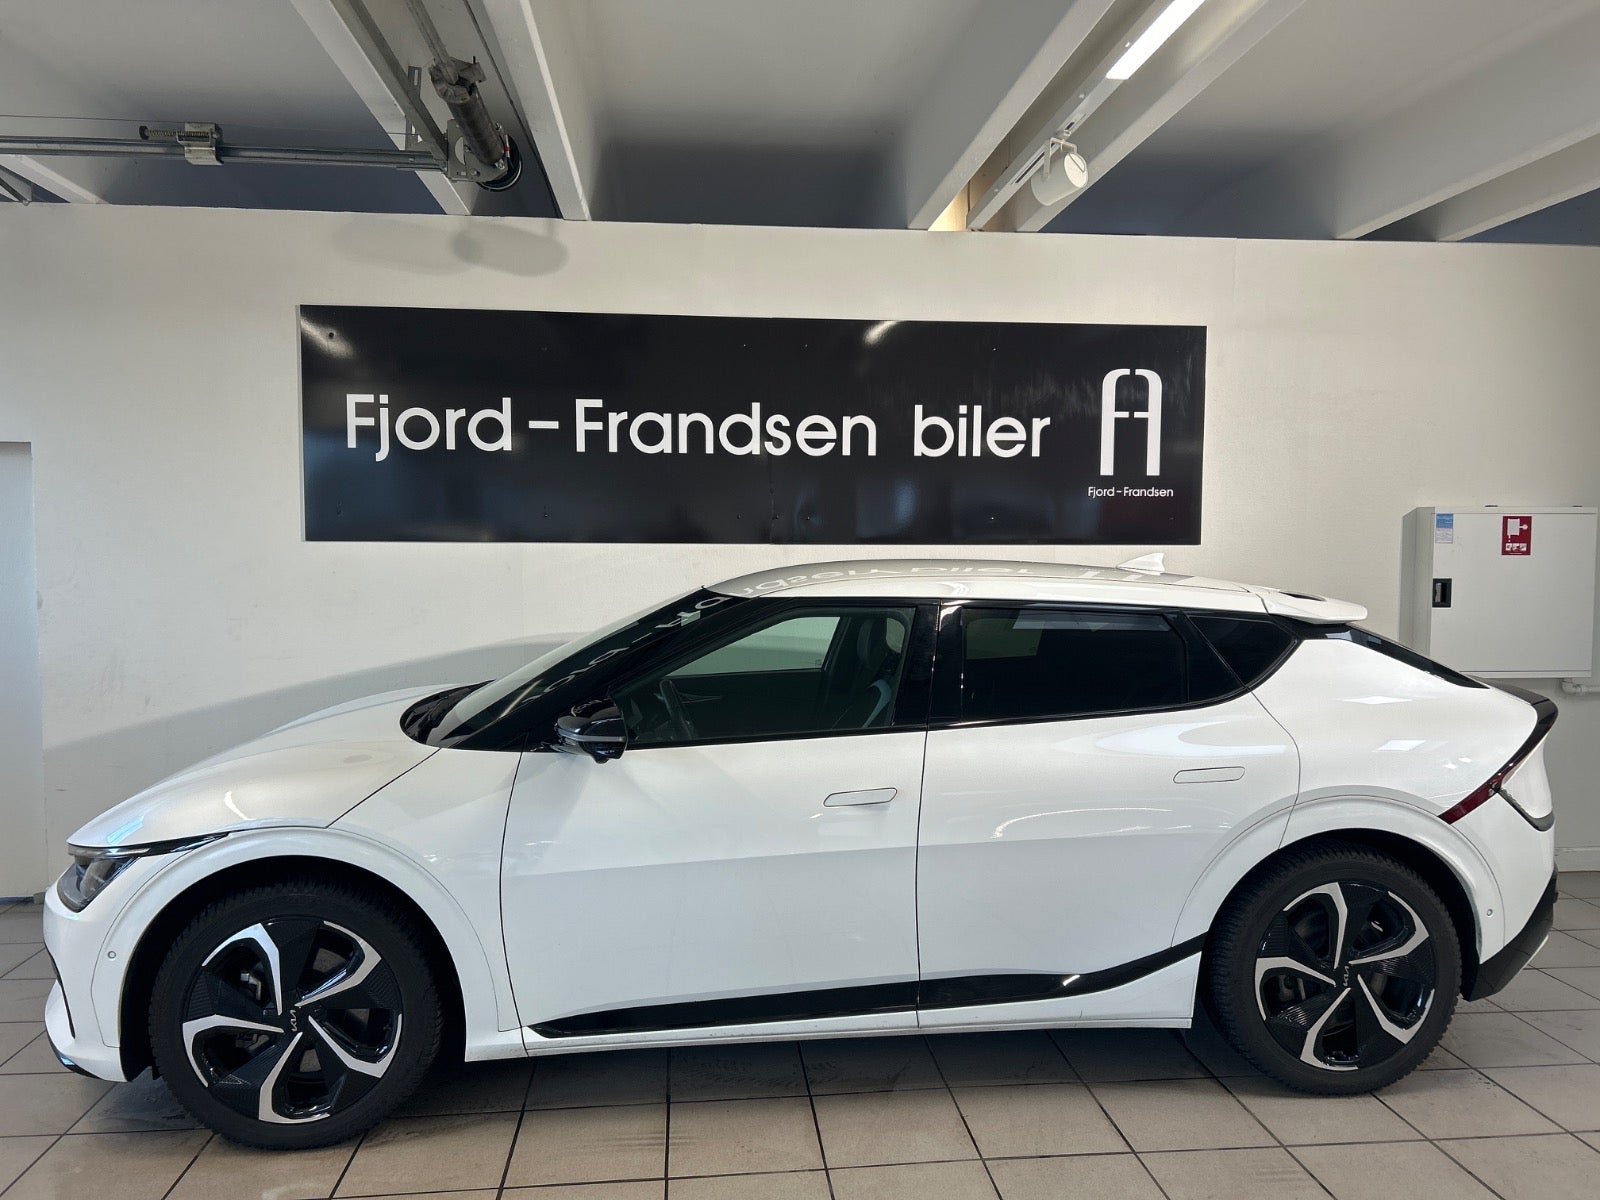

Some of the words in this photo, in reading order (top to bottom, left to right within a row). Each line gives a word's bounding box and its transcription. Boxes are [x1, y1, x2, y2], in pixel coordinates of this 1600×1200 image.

[346, 393, 513, 462] Fjord
[575, 398, 877, 457] Frandsen
[913, 404, 1051, 458] biler
